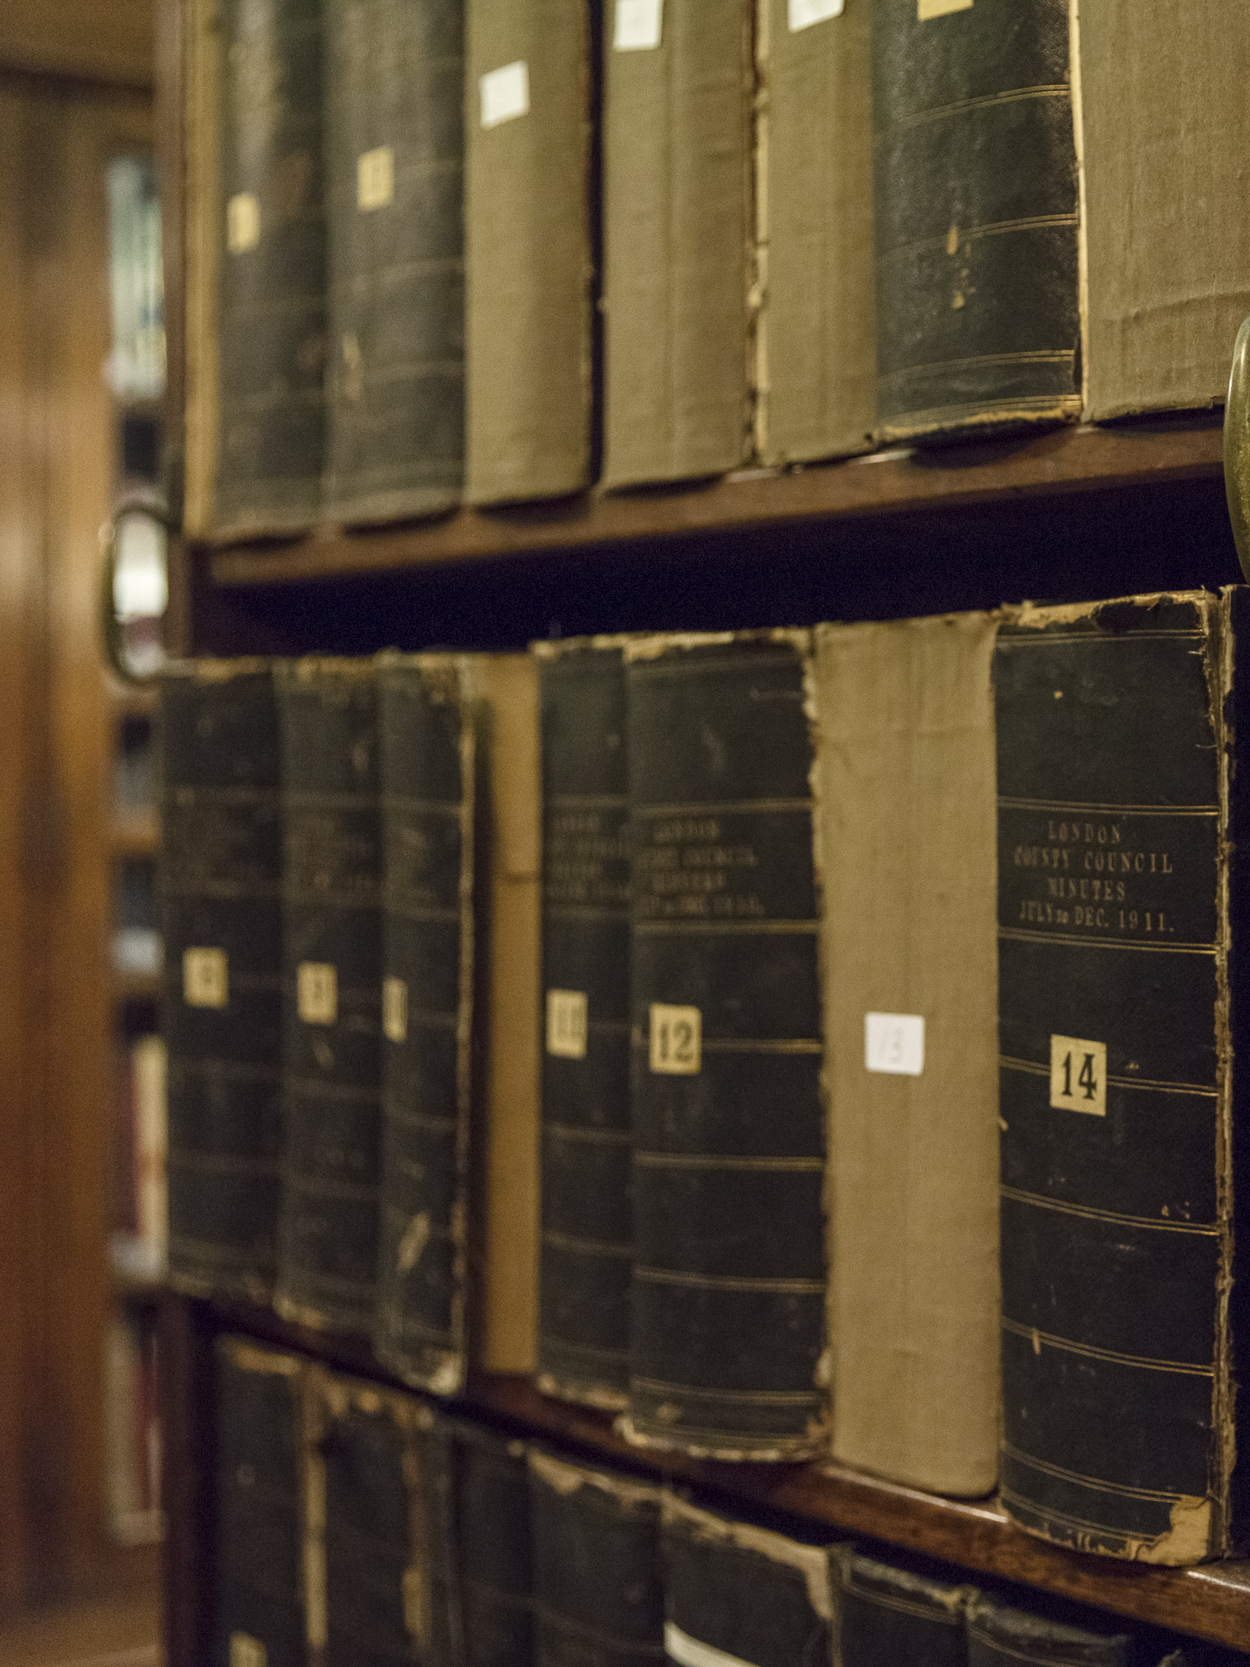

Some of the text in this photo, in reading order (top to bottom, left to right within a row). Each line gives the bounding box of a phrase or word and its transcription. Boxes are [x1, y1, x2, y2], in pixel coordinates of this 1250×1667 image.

[1047, 820, 1121, 845] LONDON
[1013, 846, 1173, 874] COUNTY COUNCIL
[1047, 877, 1126, 901] MINUTES
[1074, 905, 1110, 928] DEC.
[658, 1020, 694, 1063] 12
[1060, 1051, 1098, 1101] 14
